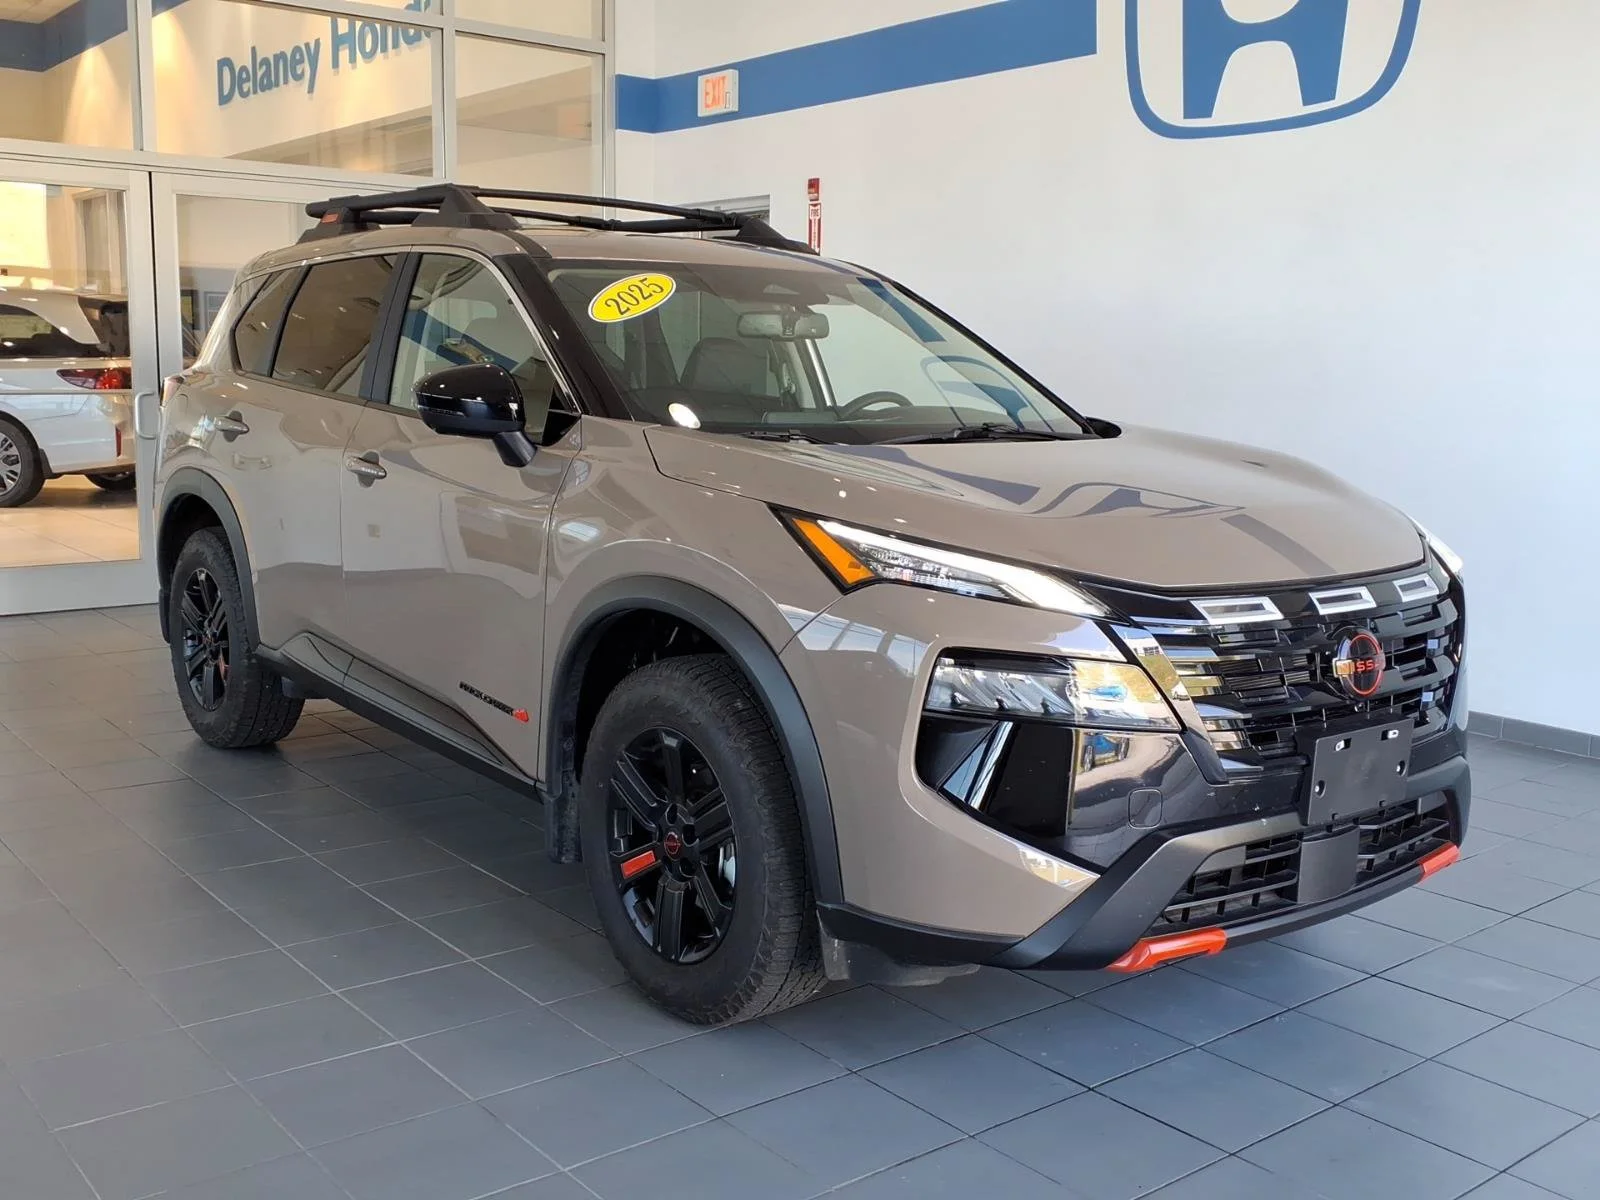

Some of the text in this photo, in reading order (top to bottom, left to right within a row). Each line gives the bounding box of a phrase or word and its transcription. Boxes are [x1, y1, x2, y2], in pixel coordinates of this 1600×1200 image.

[217, 37, 321, 107] Delaney
[704, 76, 727, 109] EXIT
[604, 277, 664, 315] 2025
